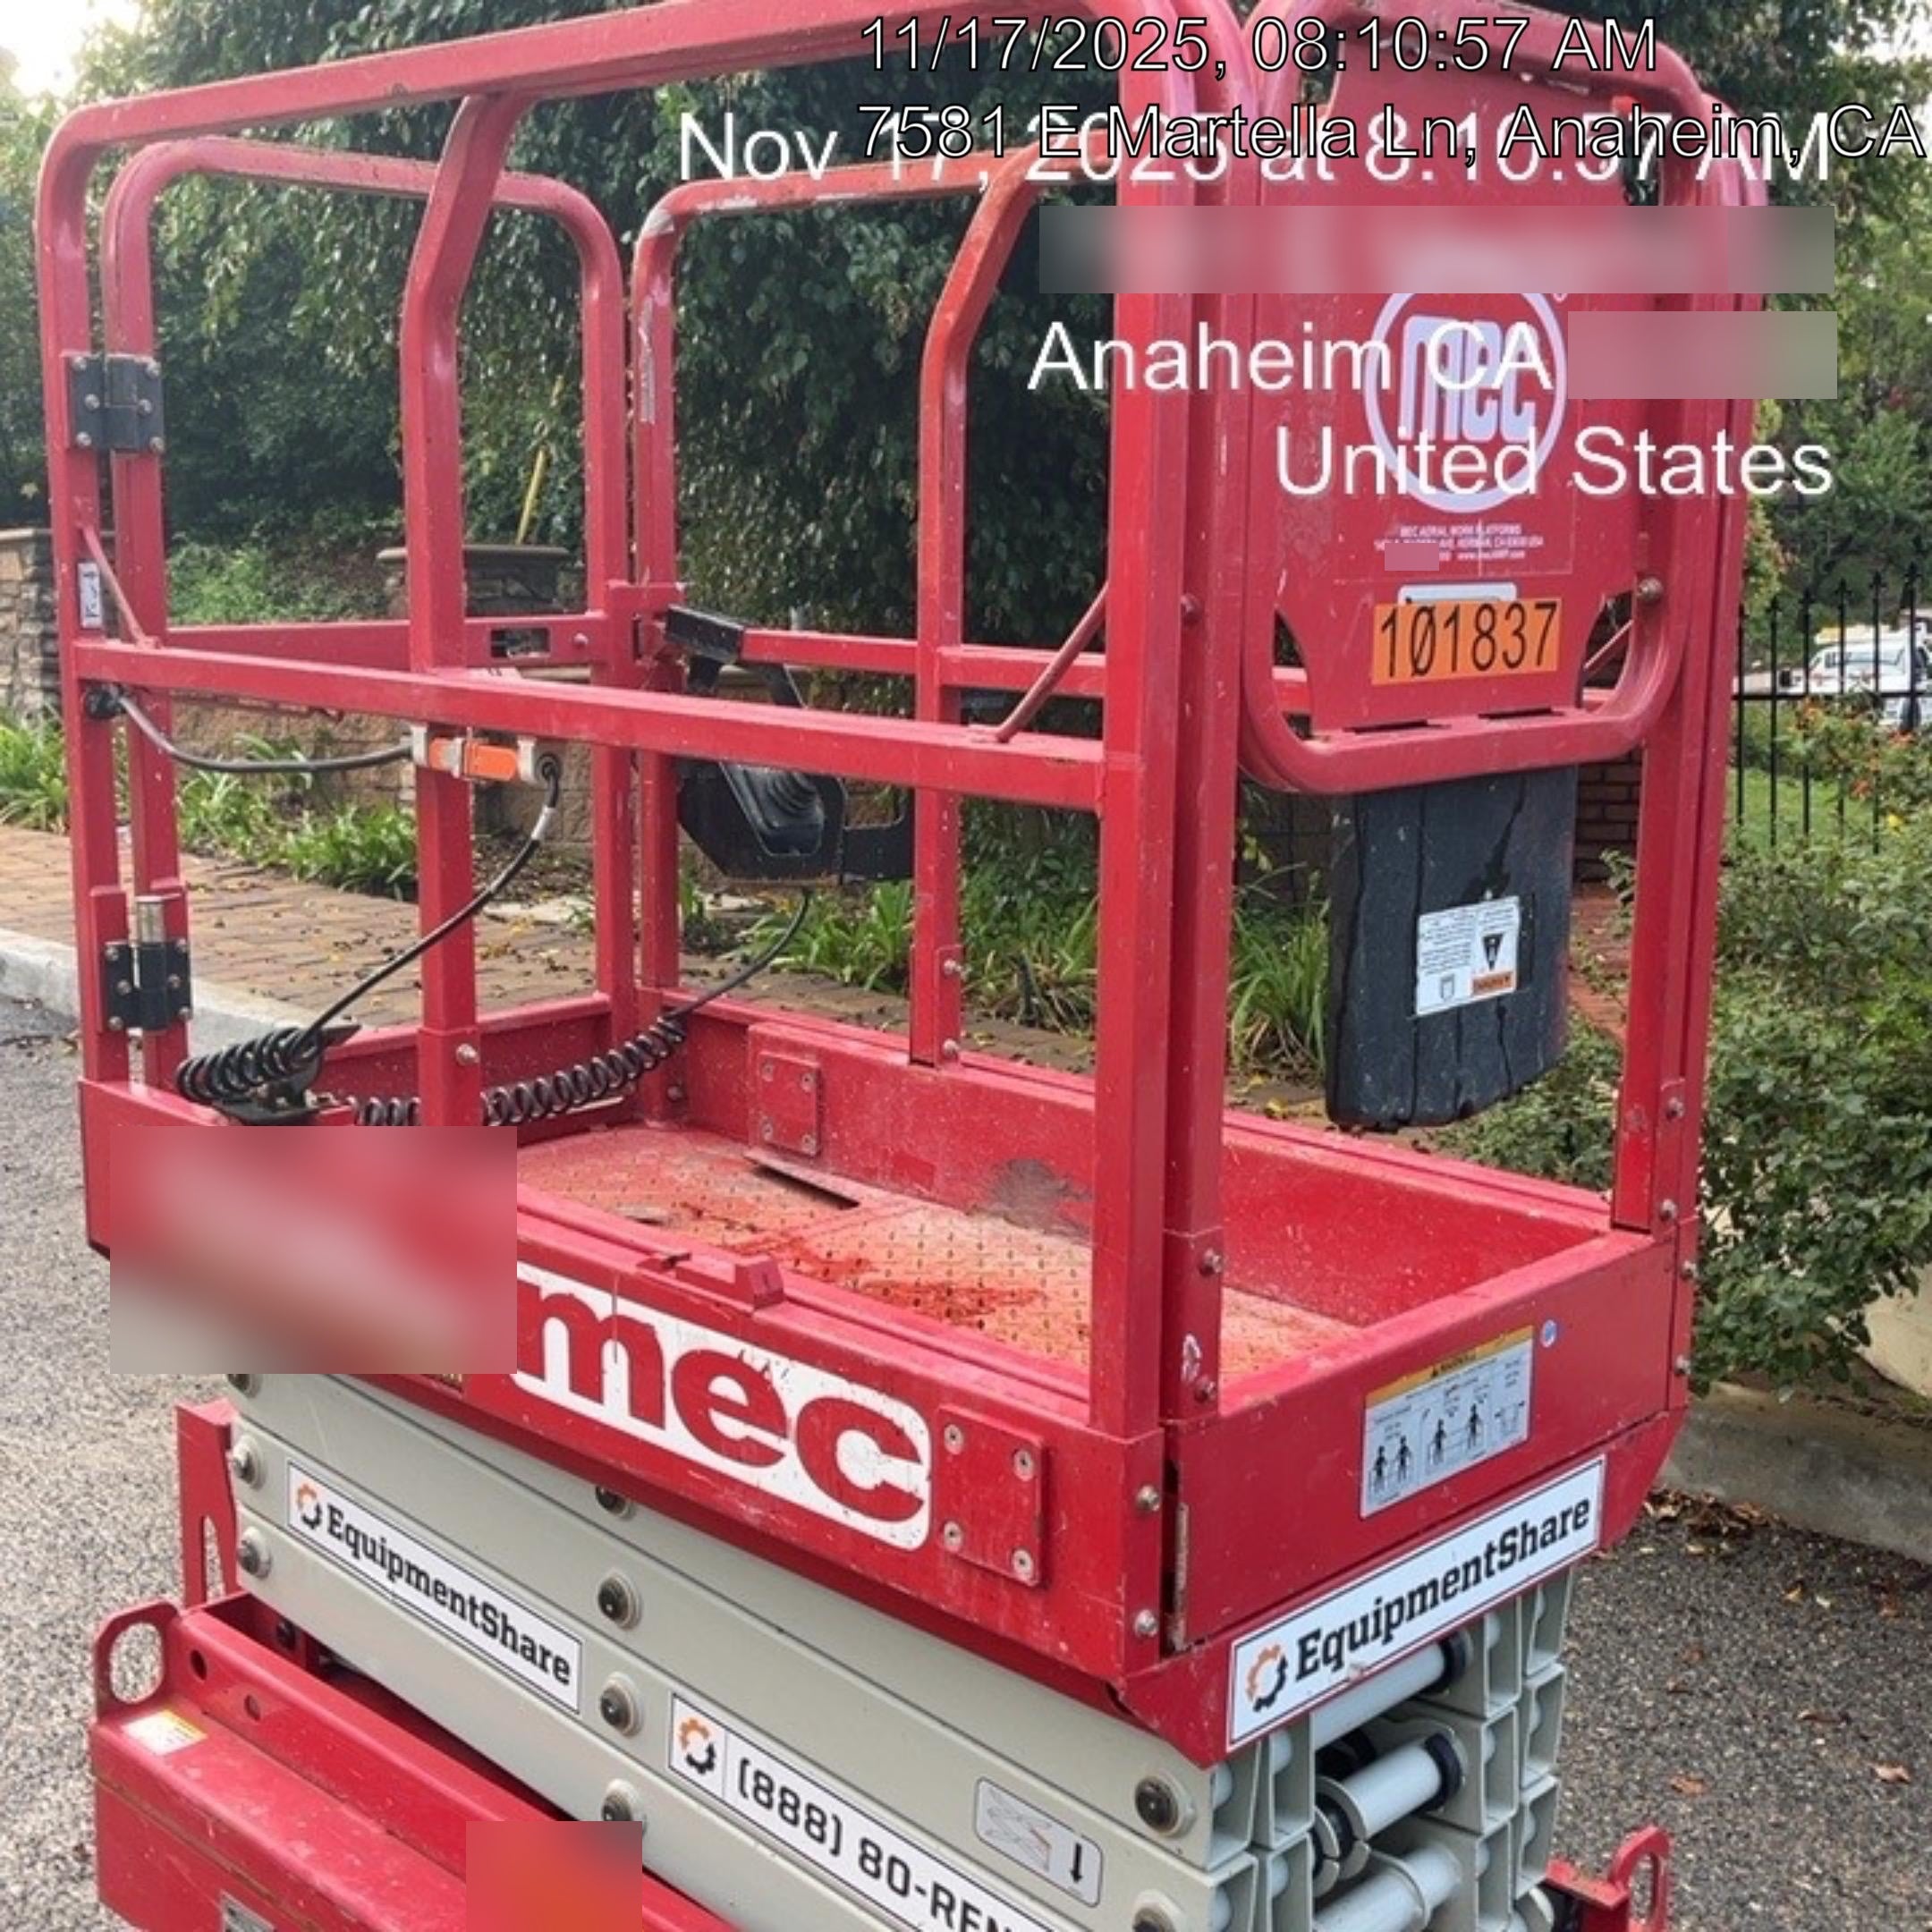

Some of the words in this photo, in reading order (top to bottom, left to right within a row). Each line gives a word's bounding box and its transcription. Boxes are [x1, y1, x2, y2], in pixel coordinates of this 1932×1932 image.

[1380, 601, 1558, 677] 101837
[517, 1281, 926, 1523] mec
[326, 1504, 572, 1687] EquipmentShare
[1295, 1497, 1590, 1682] EquipmentShare
[738, 1758, 843, 1858] (888)
